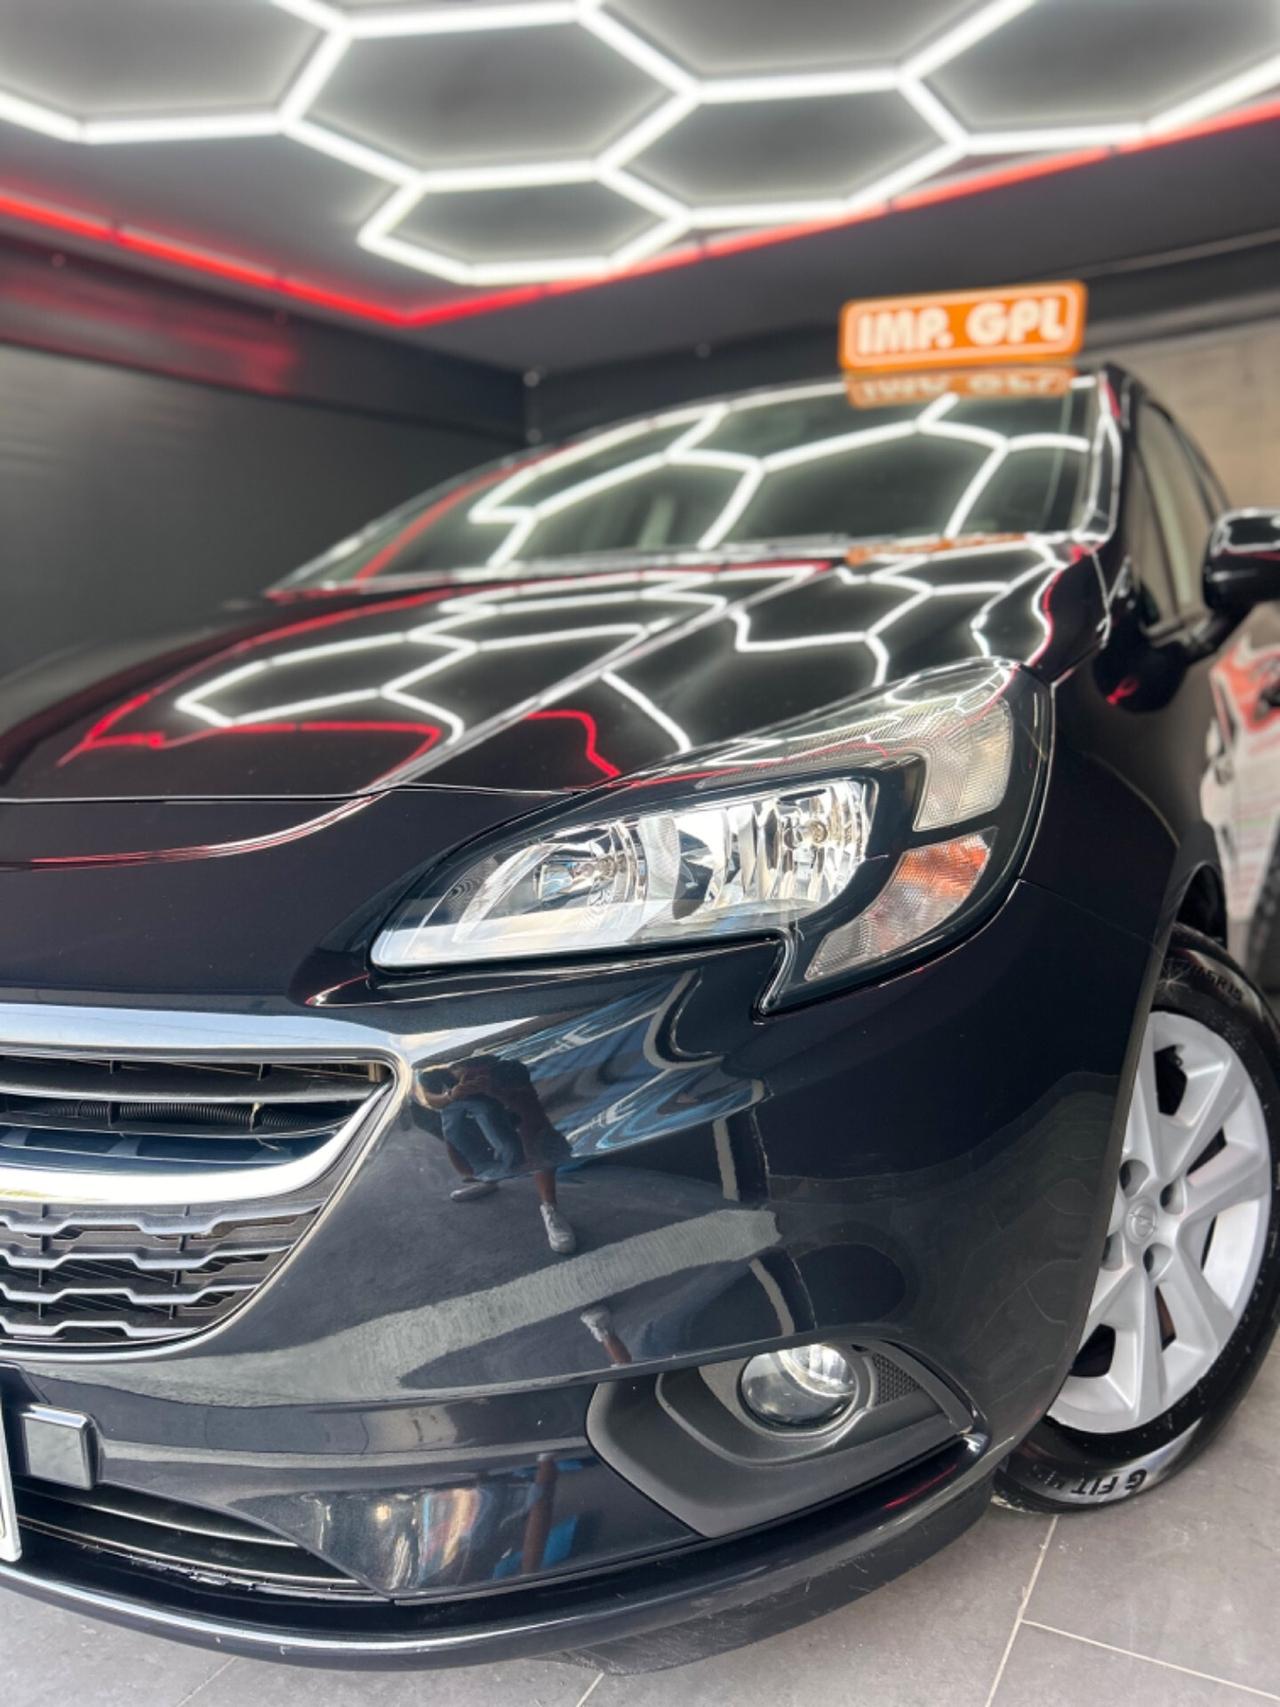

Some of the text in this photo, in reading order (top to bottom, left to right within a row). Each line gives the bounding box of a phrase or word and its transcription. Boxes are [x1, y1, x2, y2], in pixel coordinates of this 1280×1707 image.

[857, 297, 1064, 354] IMP. GPL
[1070, 1474, 1119, 1496] FIT
[1123, 1469, 1148, 1491] G
